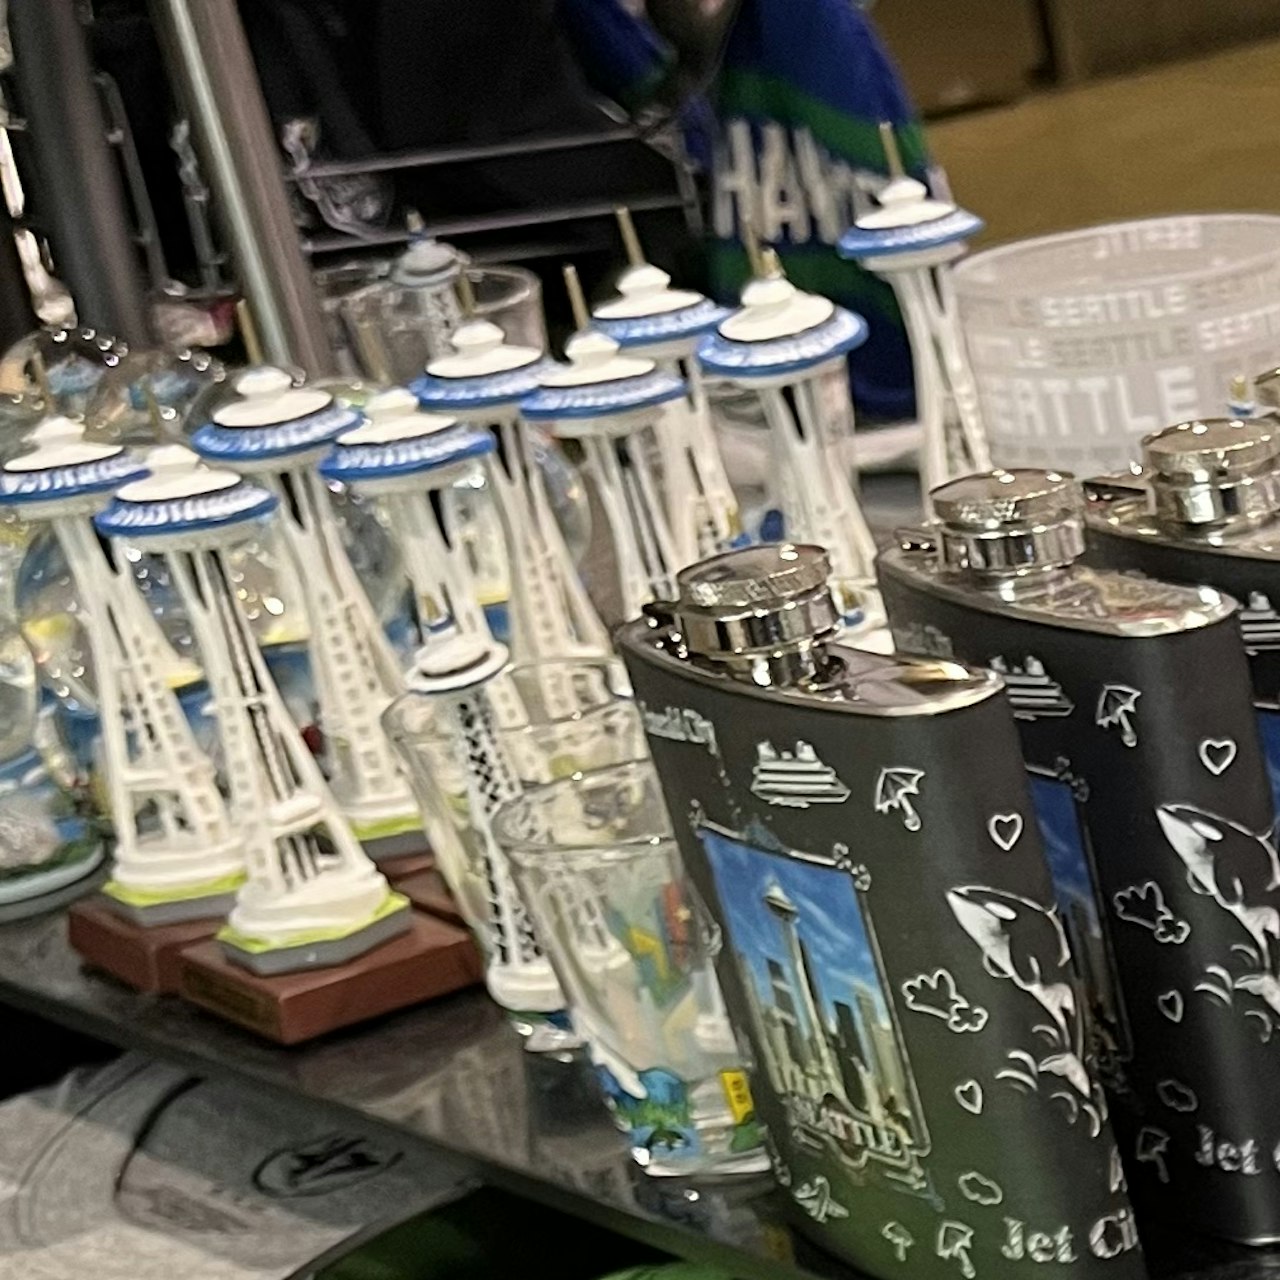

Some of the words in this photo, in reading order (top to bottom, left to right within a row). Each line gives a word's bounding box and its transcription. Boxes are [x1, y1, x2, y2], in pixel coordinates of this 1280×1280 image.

[1043, 286, 1187, 327] SEATTLE
[988, 366, 1200, 436] EATTLE
[1196, 1125, 1261, 1175] Jet
[1001, 1216, 1078, 1264] Jet
[1088, 1208, 1139, 1260] Ci
